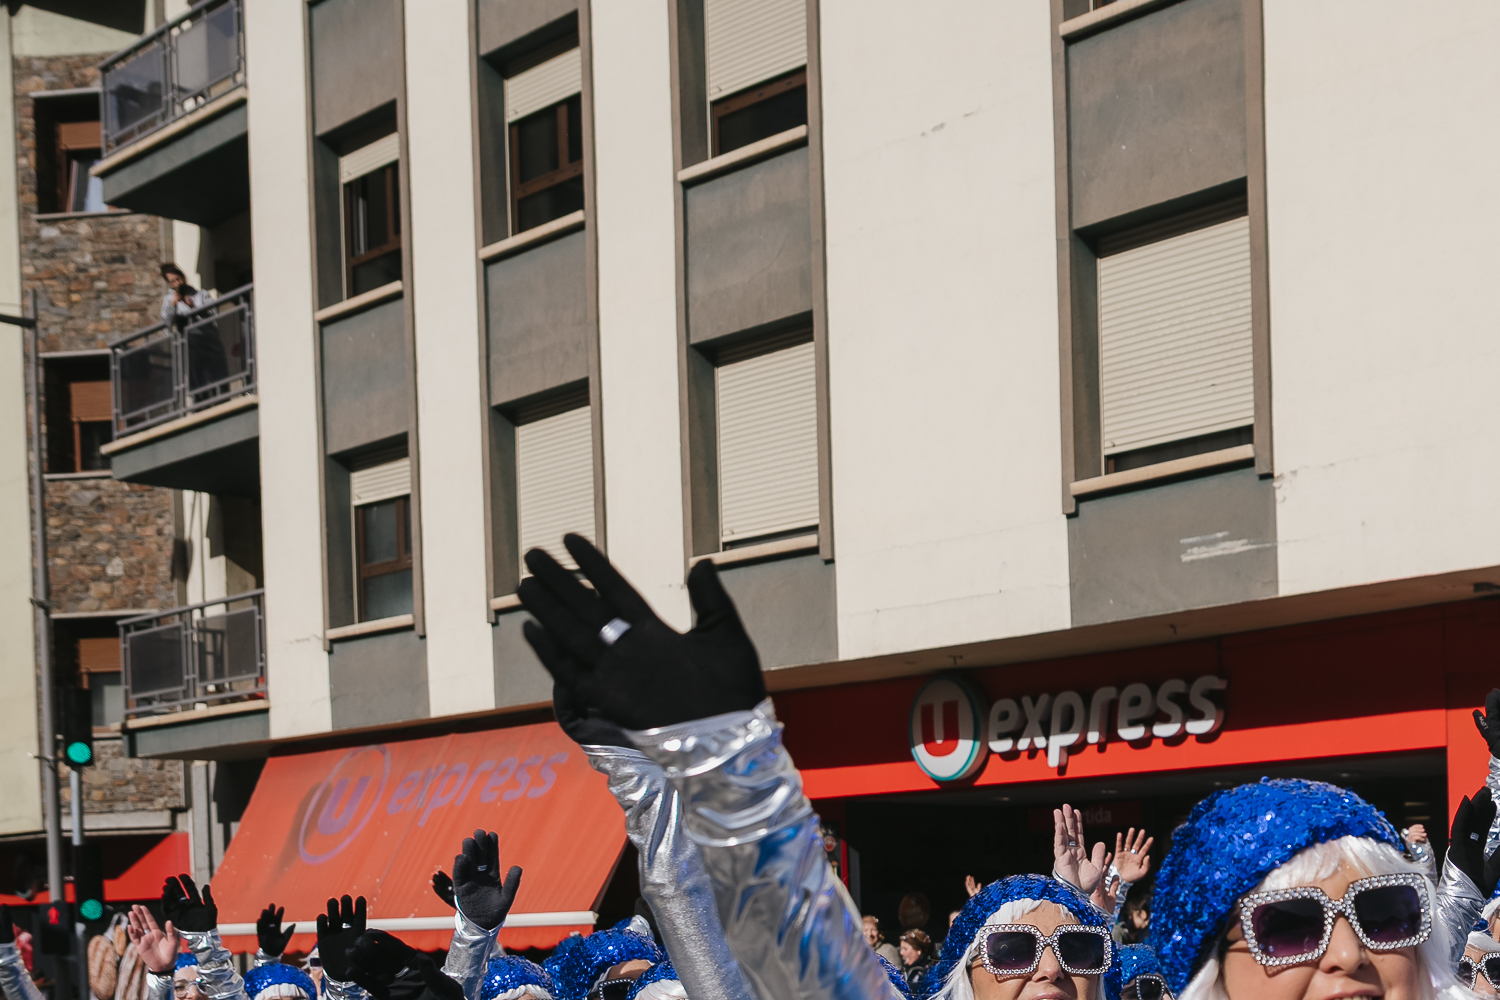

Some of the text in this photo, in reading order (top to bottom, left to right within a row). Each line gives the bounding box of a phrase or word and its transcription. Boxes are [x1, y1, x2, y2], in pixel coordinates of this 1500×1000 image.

[988, 675, 1226, 768] express
[317, 752, 570, 836] U express
